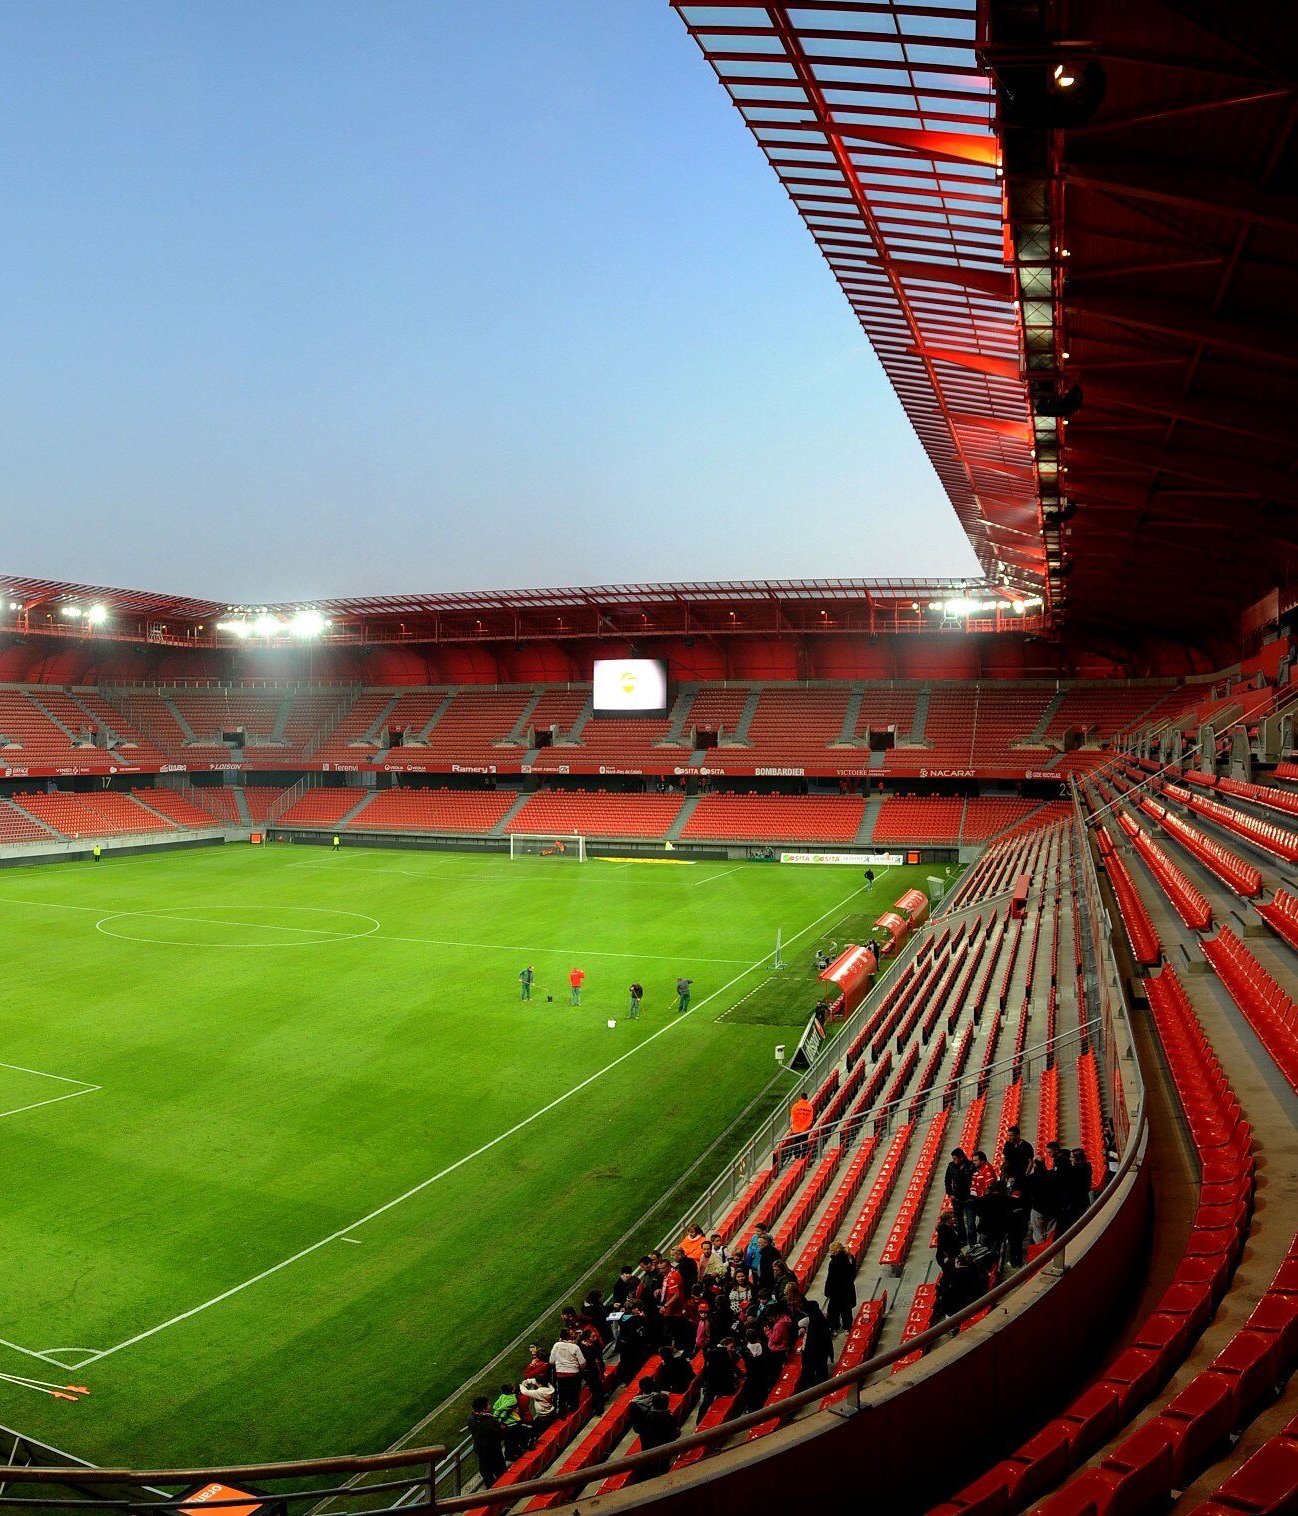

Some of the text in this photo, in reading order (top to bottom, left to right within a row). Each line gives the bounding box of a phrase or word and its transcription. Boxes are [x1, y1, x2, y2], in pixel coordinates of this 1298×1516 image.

[334, 763, 358, 771] Terenvi
[452, 764, 488, 773] Ramery
[755, 768, 805, 776] BOMBARDIER
[102, 777, 112, 788] 17
